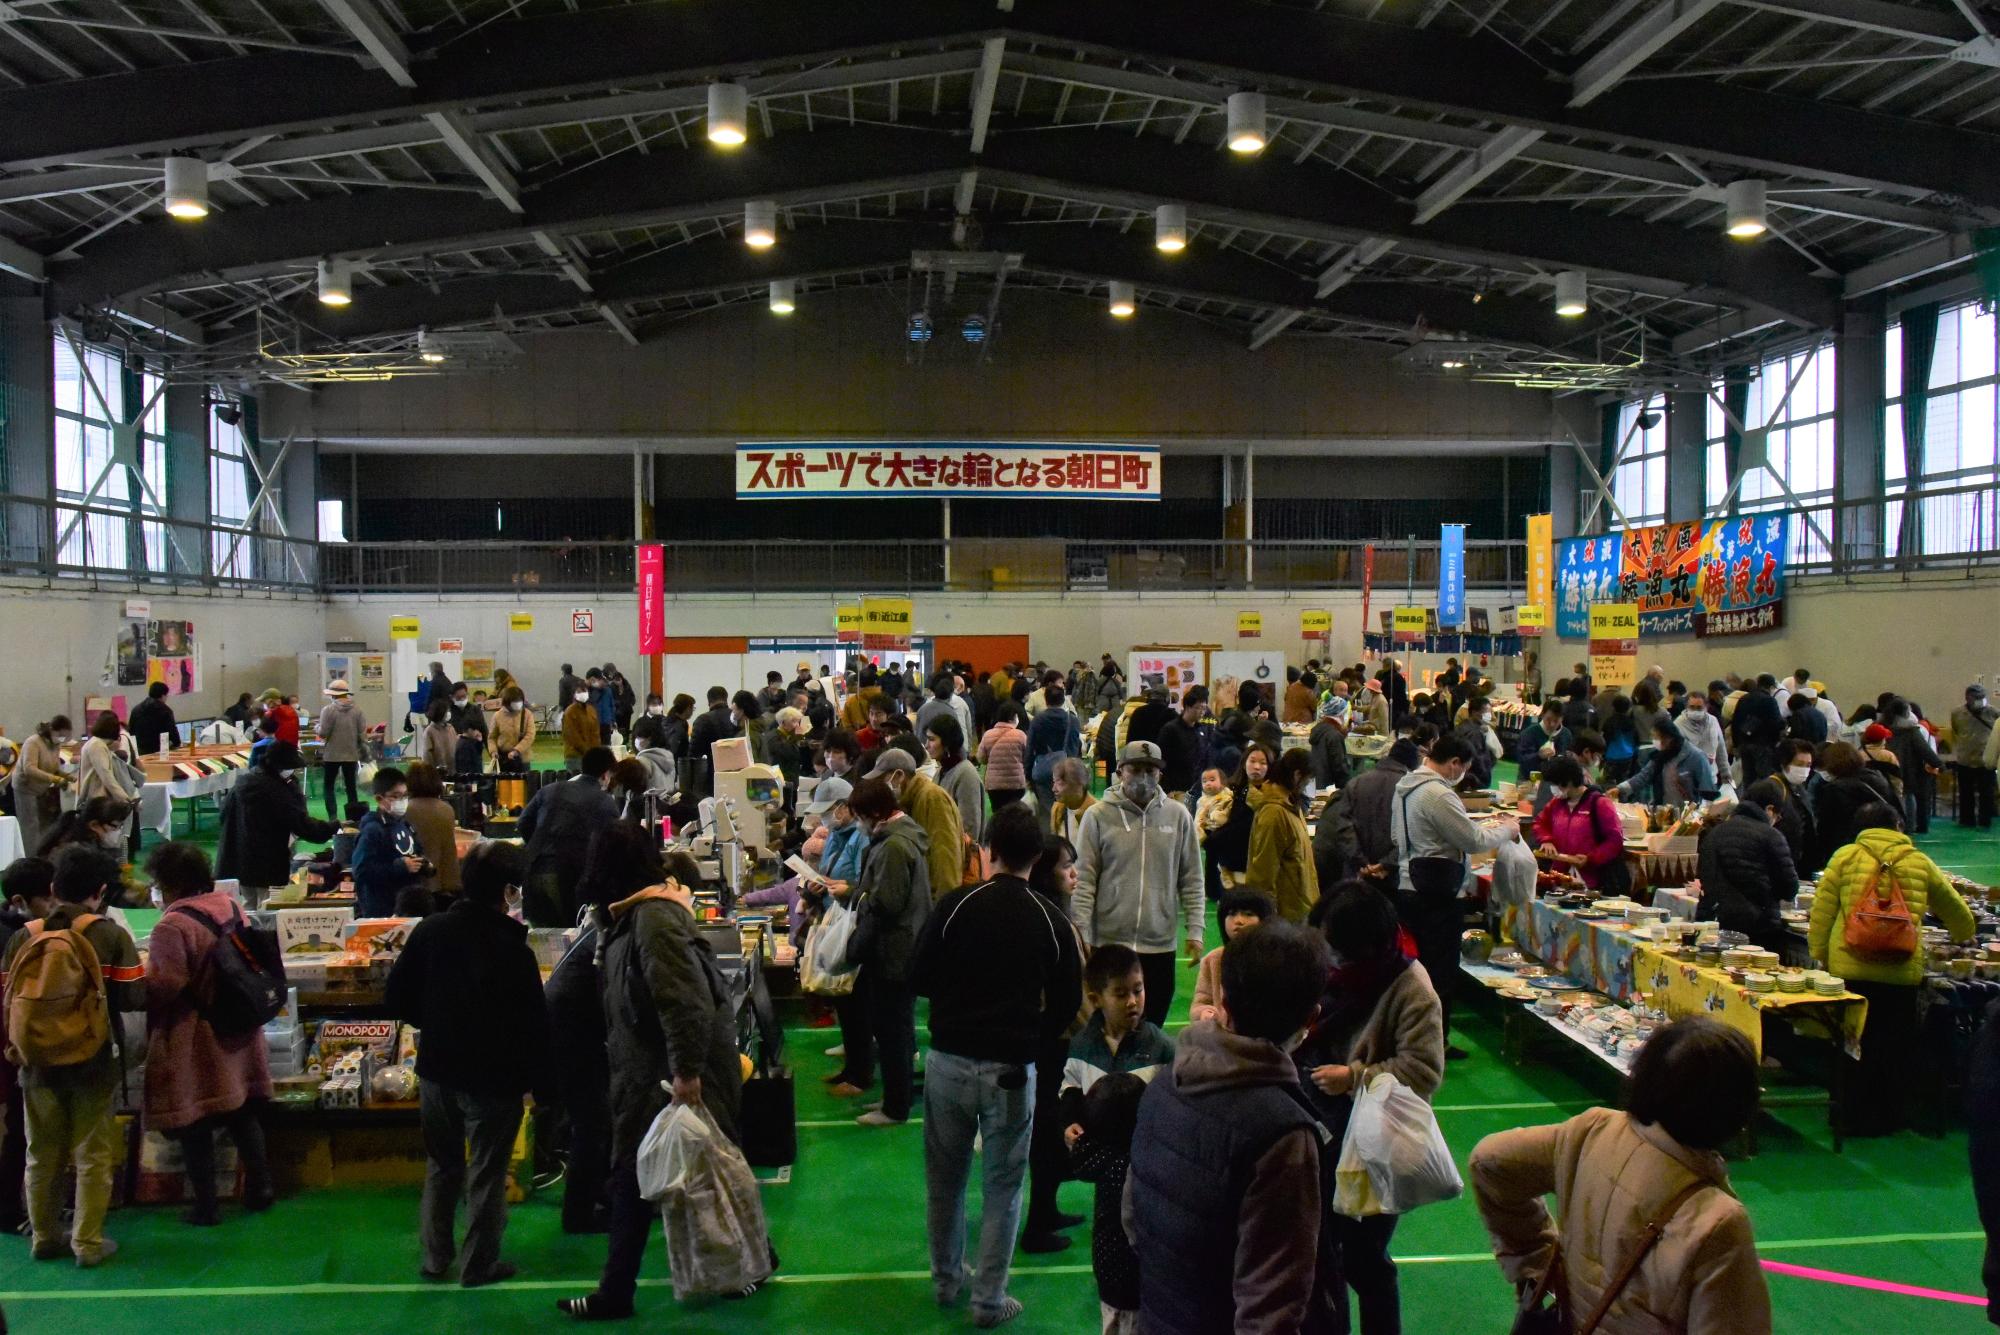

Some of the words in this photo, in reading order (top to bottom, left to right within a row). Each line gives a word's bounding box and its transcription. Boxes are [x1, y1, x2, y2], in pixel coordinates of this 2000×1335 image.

[746, 451, 1152, 490] スポーツで大きな輪となる朝日町
[324, 1025, 390, 1038] MONOPOLY
